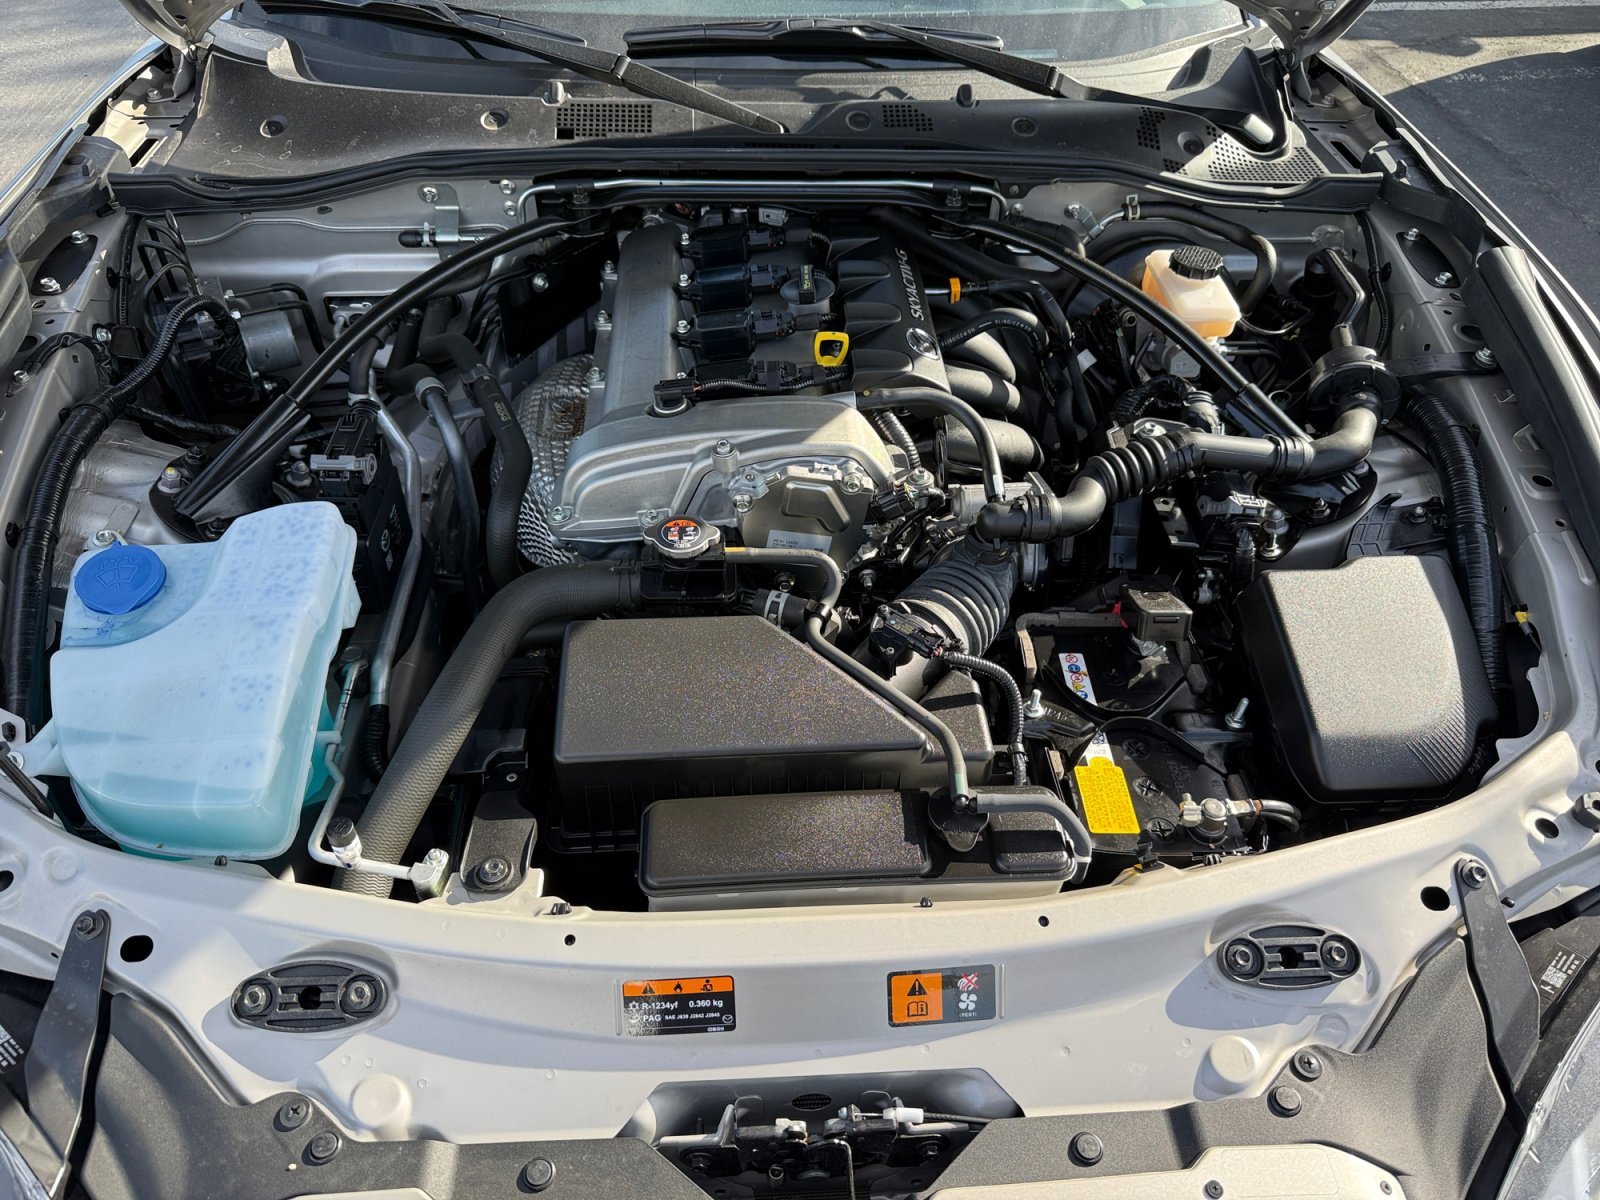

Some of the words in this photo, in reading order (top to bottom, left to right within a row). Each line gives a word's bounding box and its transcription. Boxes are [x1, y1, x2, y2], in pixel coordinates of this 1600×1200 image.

[895, 247, 924, 321] SKYACTIV-G
[641, 1001, 679, 1010] R-1234yf
[689, 999, 711, 1008] 0.360
[713, 999, 723, 1009] kg
[642, 1014, 662, 1022] PAG
